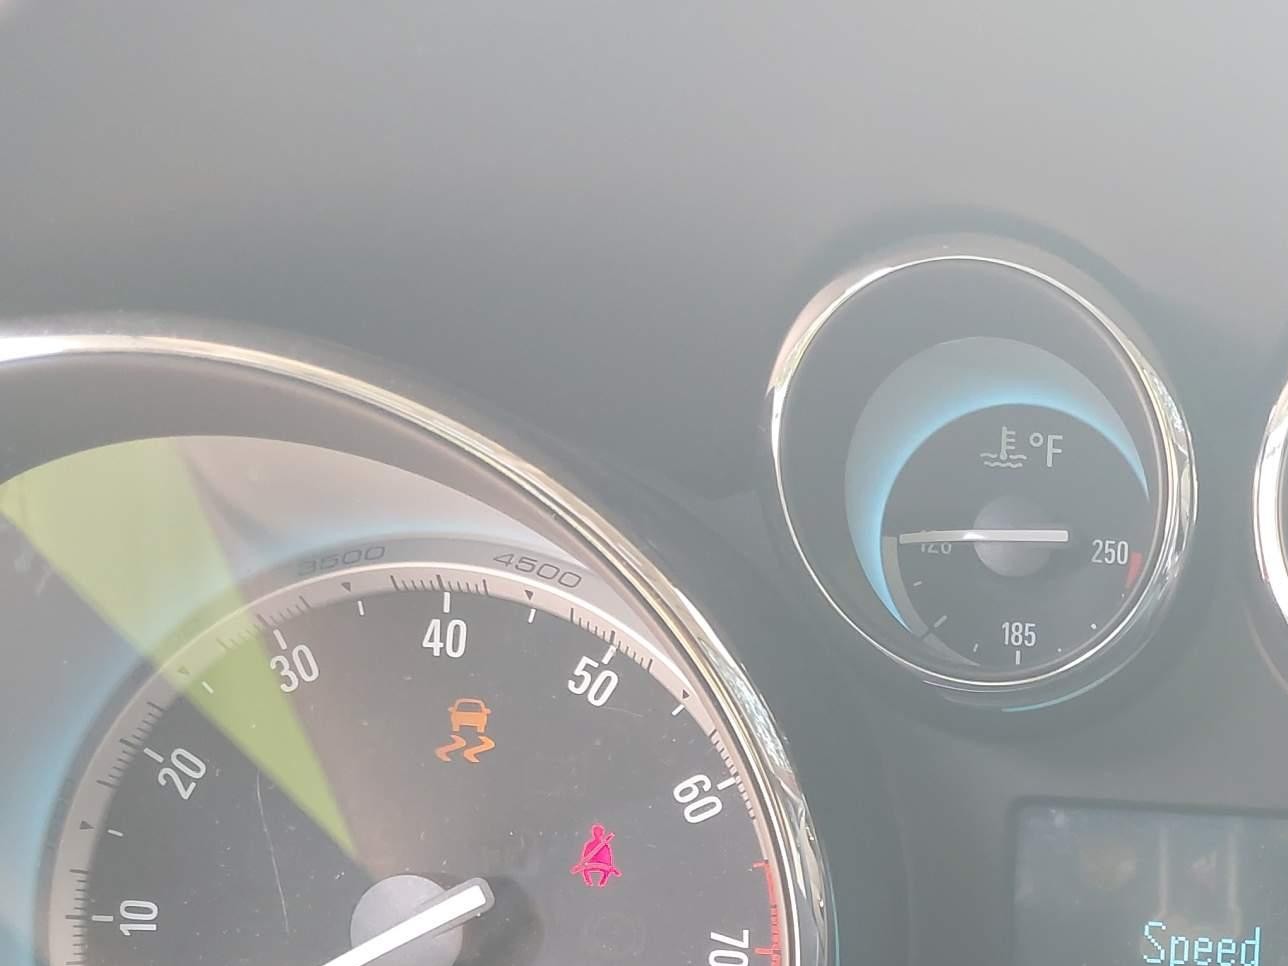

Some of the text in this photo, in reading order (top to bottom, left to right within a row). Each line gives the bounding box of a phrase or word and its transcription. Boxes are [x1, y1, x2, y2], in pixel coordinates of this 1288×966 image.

[493, 552, 583, 589] 4500
[1091, 540, 1129, 565] 250
[422, 618, 468, 658] 40
[1001, 622, 1037, 646] 185
[270, 644, 320, 692] 30
[567, 655, 619, 707] 50
[157, 747, 207, 800] 20
[672, 773, 723, 824] 60
[119, 900, 159, 936] 10
